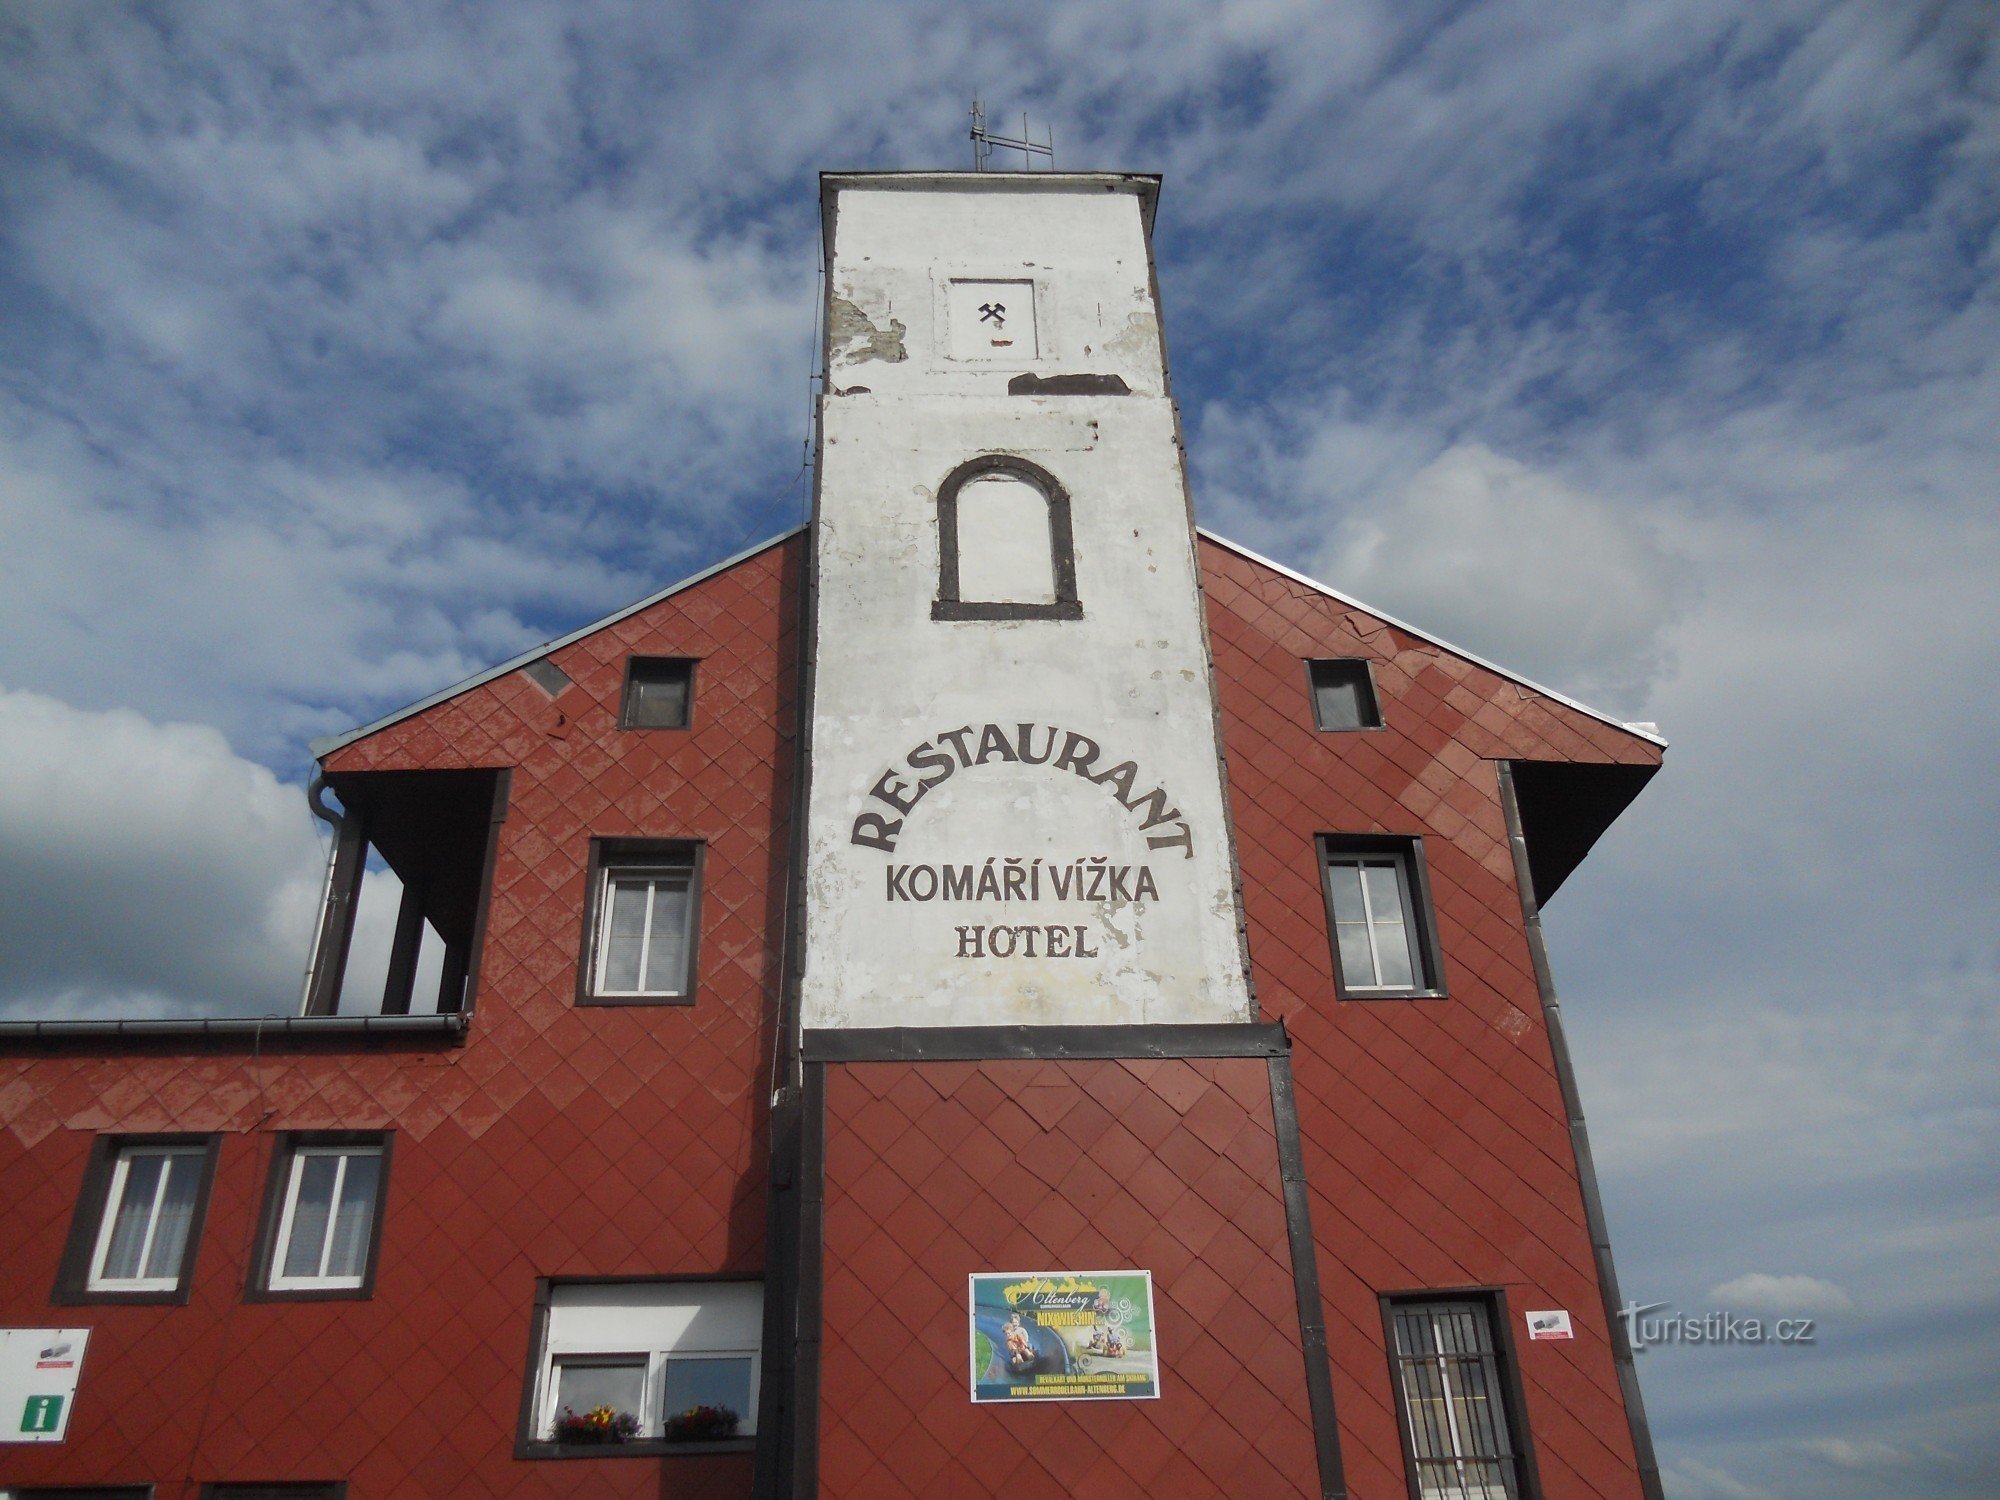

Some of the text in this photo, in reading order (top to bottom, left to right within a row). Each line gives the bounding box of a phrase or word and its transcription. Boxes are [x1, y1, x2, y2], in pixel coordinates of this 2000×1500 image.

[851, 723, 1193, 859] RESTAURANT
[886, 856, 1160, 902] KOMÁŘÍ VÍŽKA
[954, 925, 1099, 958] HOTEL
[1006, 1277, 1090, 1315] Altenberg
